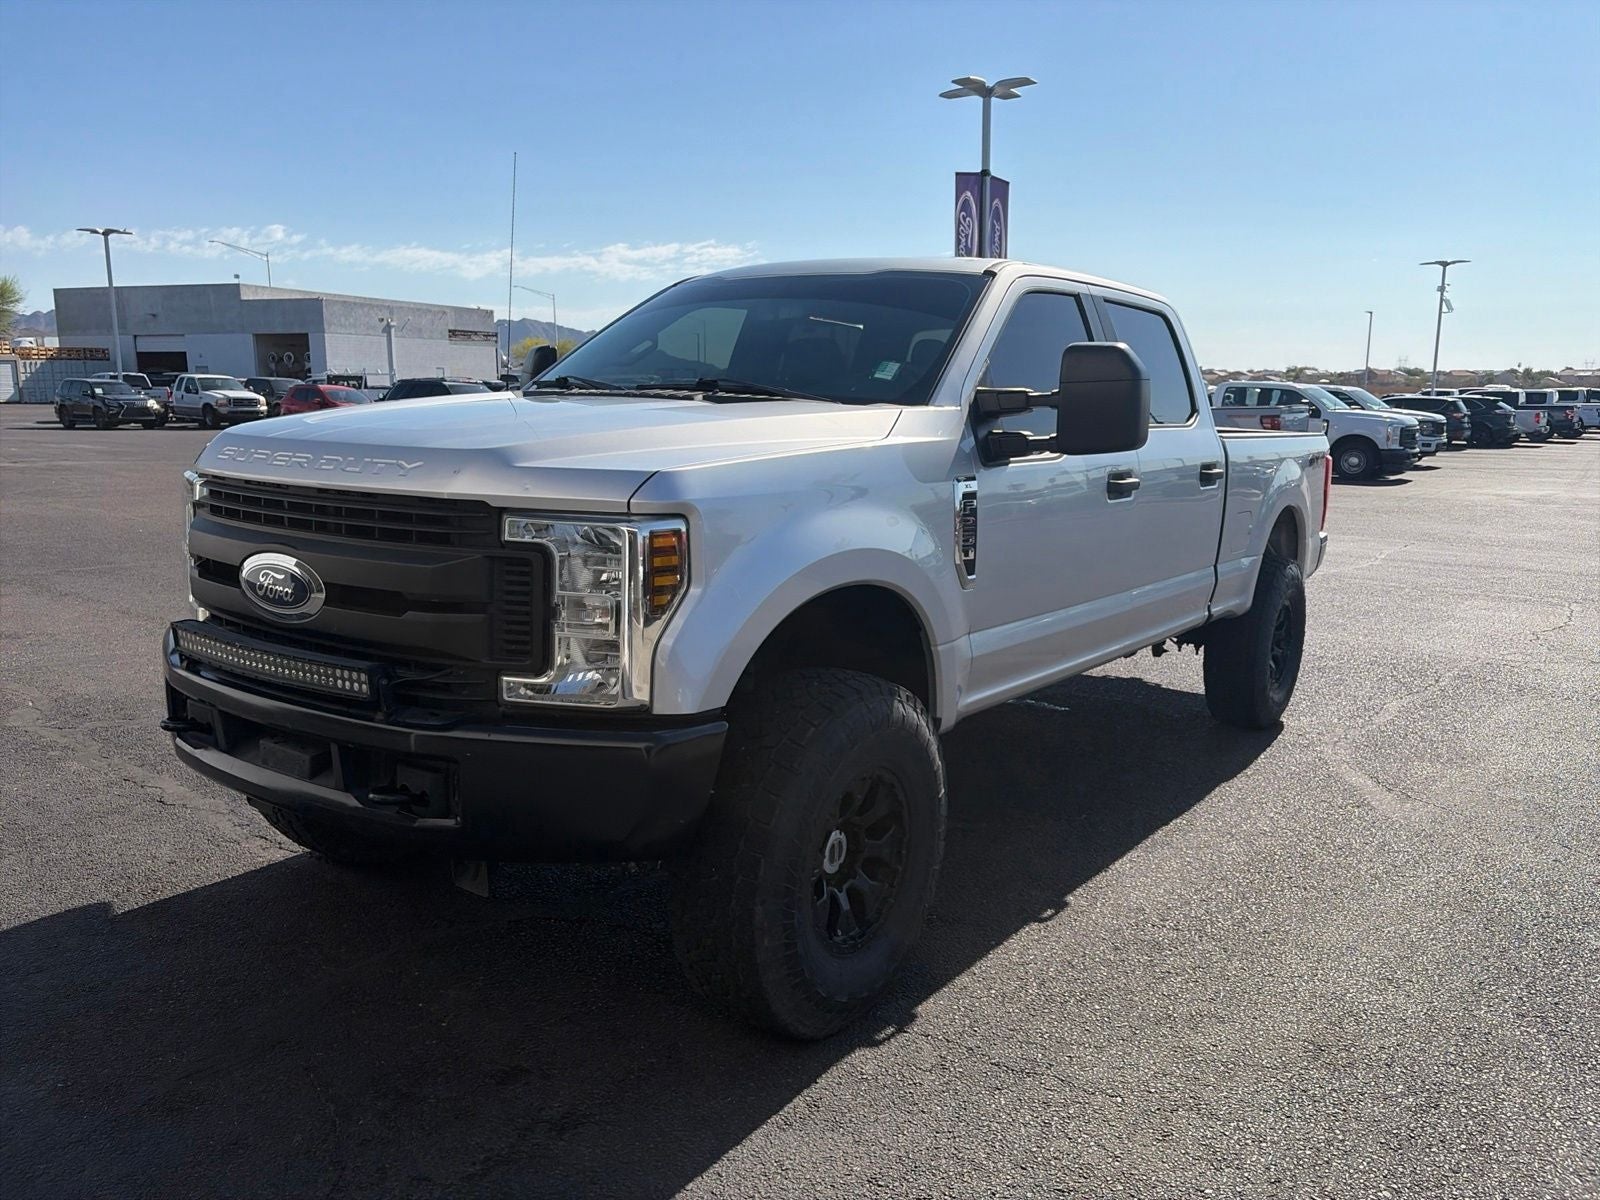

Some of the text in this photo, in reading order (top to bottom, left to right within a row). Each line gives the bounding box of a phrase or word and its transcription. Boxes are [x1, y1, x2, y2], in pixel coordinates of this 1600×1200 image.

[959, 211, 973, 257] Ford
[217, 446, 424, 477] SUPER DUTY
[256, 569, 295, 602] Ford
